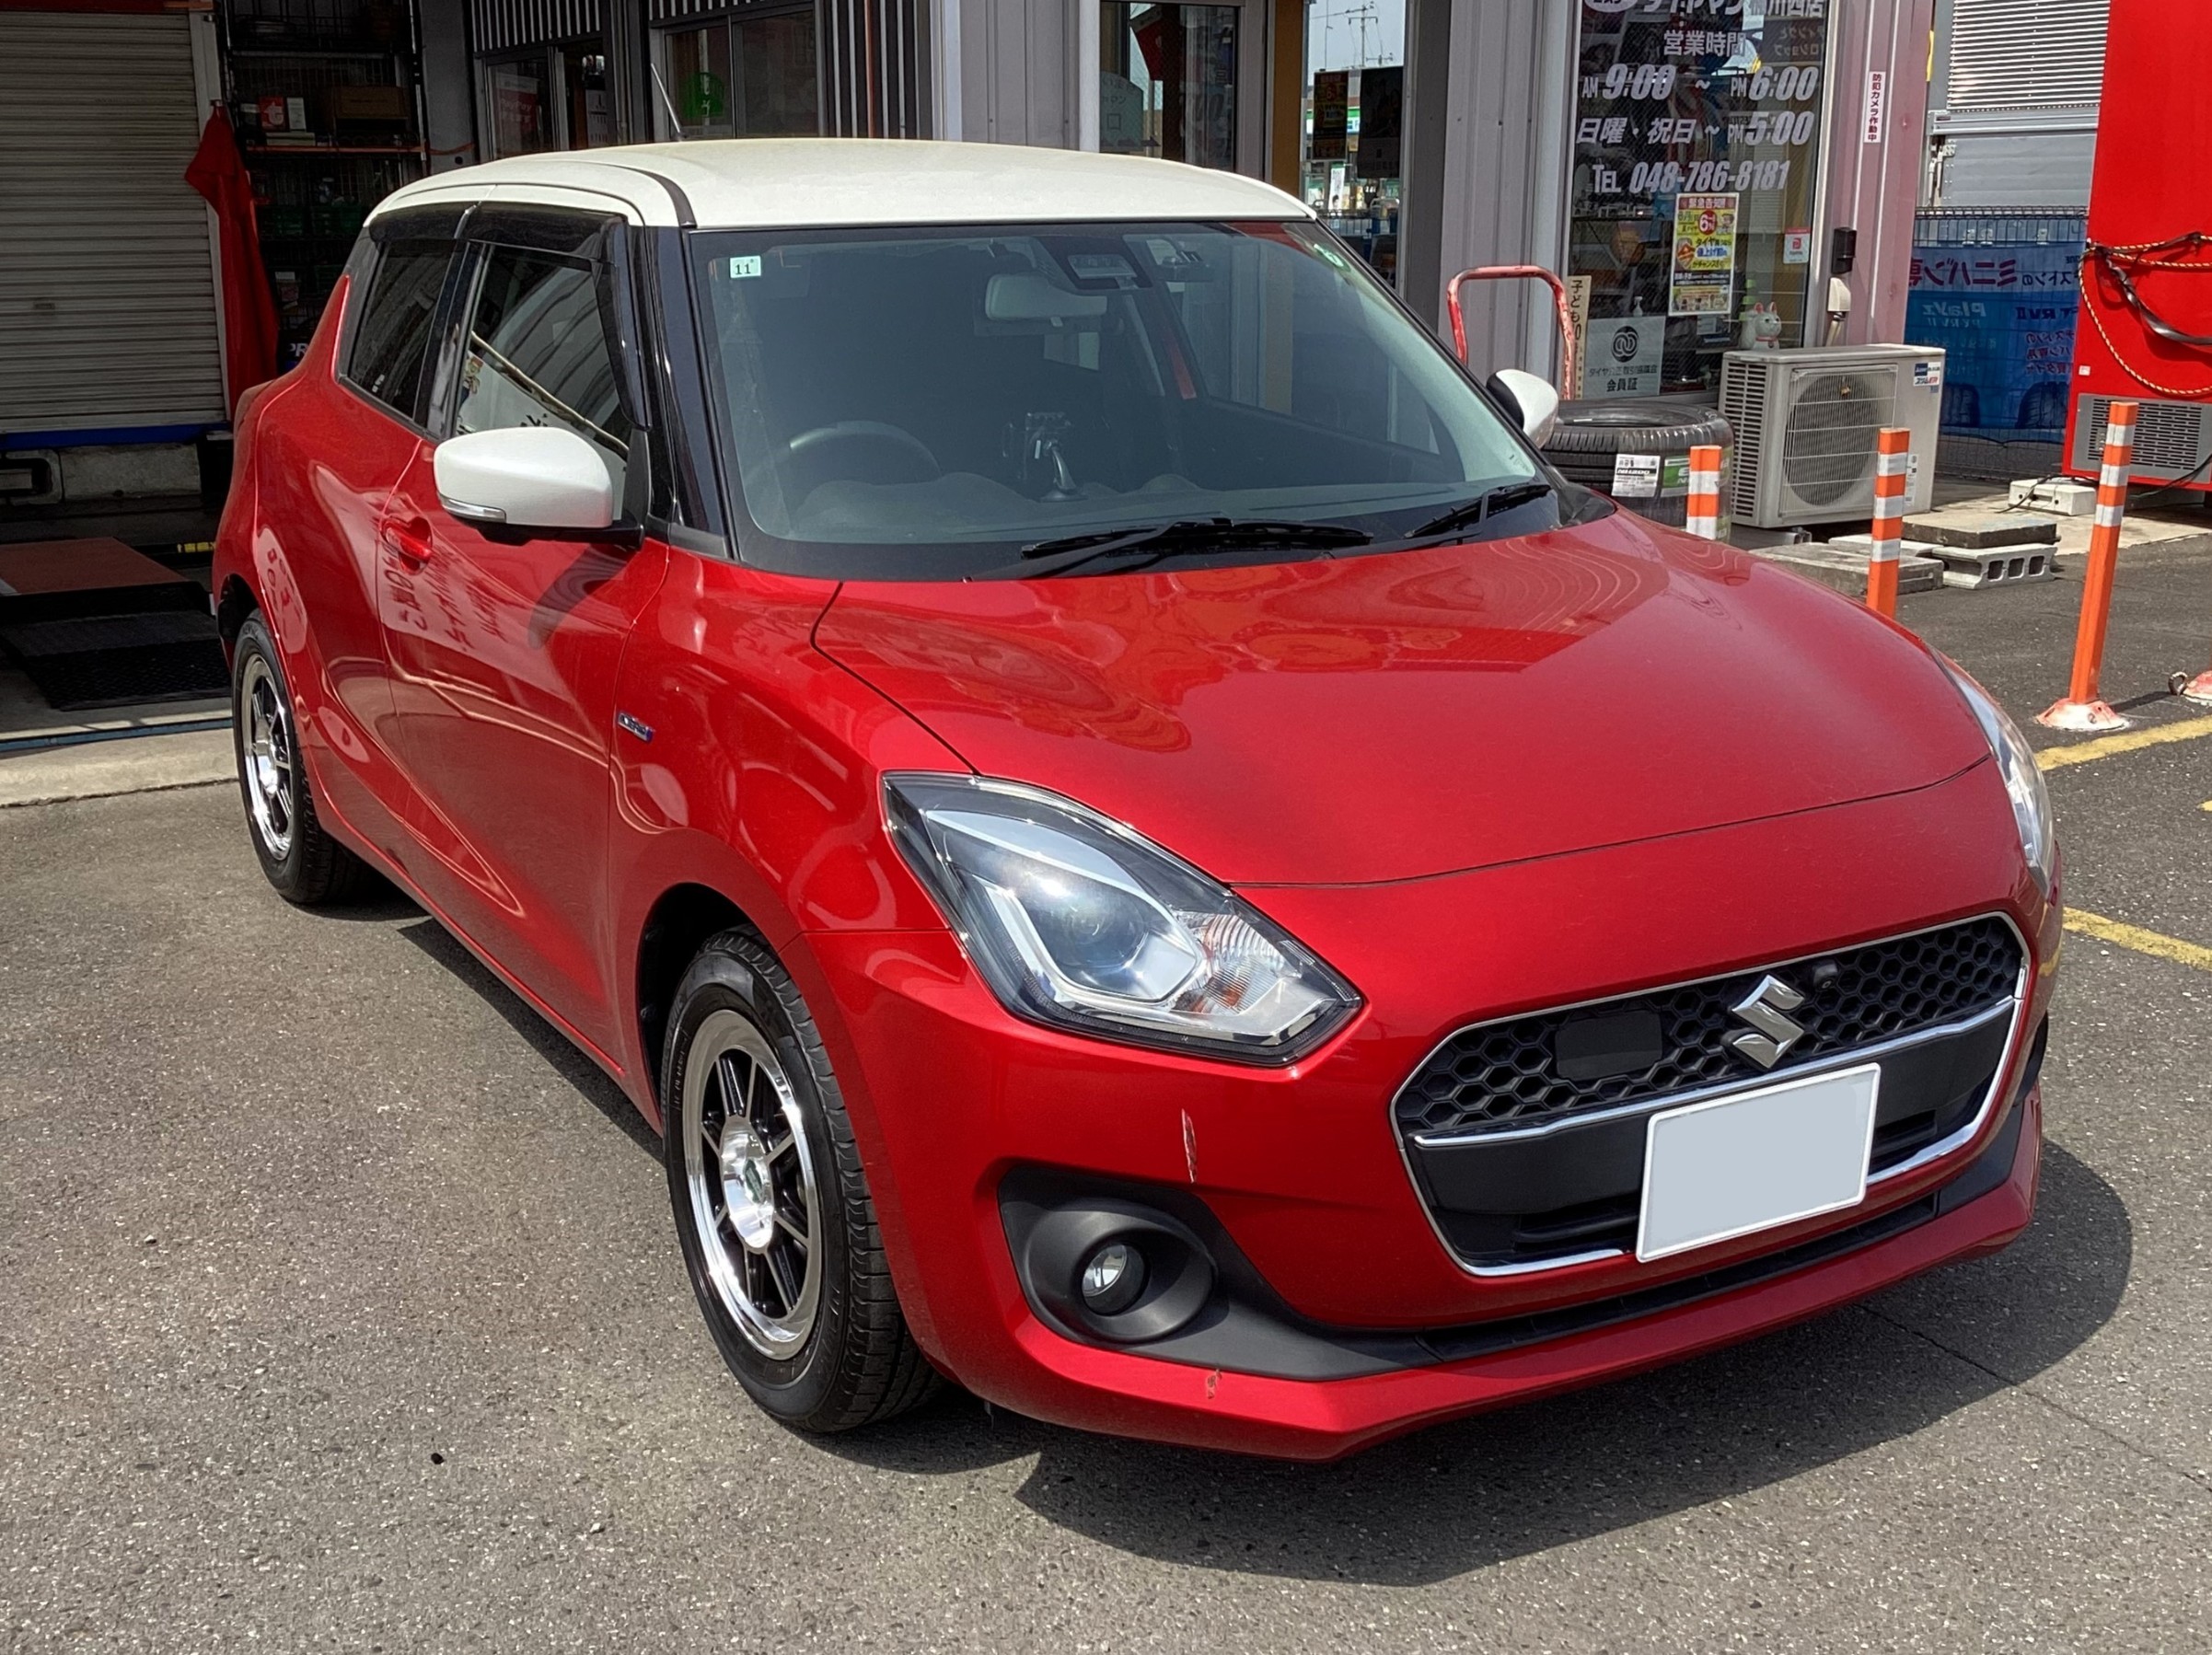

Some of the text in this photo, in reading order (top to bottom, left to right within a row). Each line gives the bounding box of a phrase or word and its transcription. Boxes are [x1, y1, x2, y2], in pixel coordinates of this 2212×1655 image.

[1663, 29, 1746, 57] 営業時間
[1582, 76, 1599, 98] AM
[1603, 64, 1676, 100] 9:00
[1731, 79, 1747, 98] PM
[1749, 66, 1819, 101] 6:00
[1868, 74, 1882, 142] 防犯カメラ作動中
[1727, 125, 1744, 145] PM
[1745, 111, 1815, 145] 5:00
[1628, 160, 1791, 194] 048-786-8181
[735, 263, 751, 275] 11
[1606, 377, 1639, 392] 会員証
